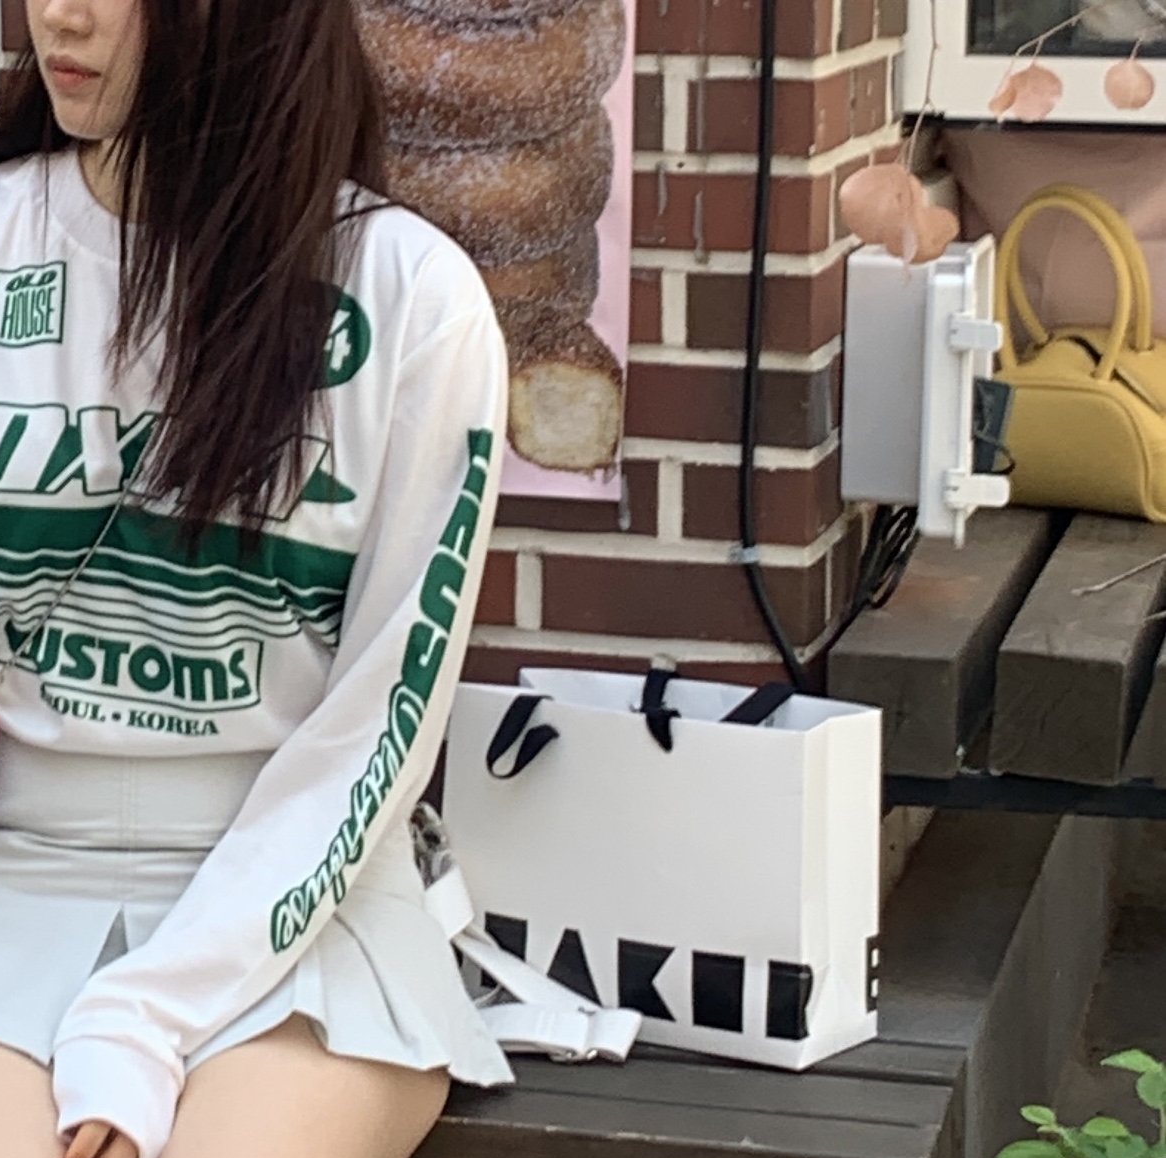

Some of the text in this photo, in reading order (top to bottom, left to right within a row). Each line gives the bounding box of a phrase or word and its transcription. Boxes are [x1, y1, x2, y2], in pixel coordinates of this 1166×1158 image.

[5, 270, 57, 291] OLD
[0, 286, 56, 339] HOUSE
[46, 693, 220, 737] OUL KOREA
